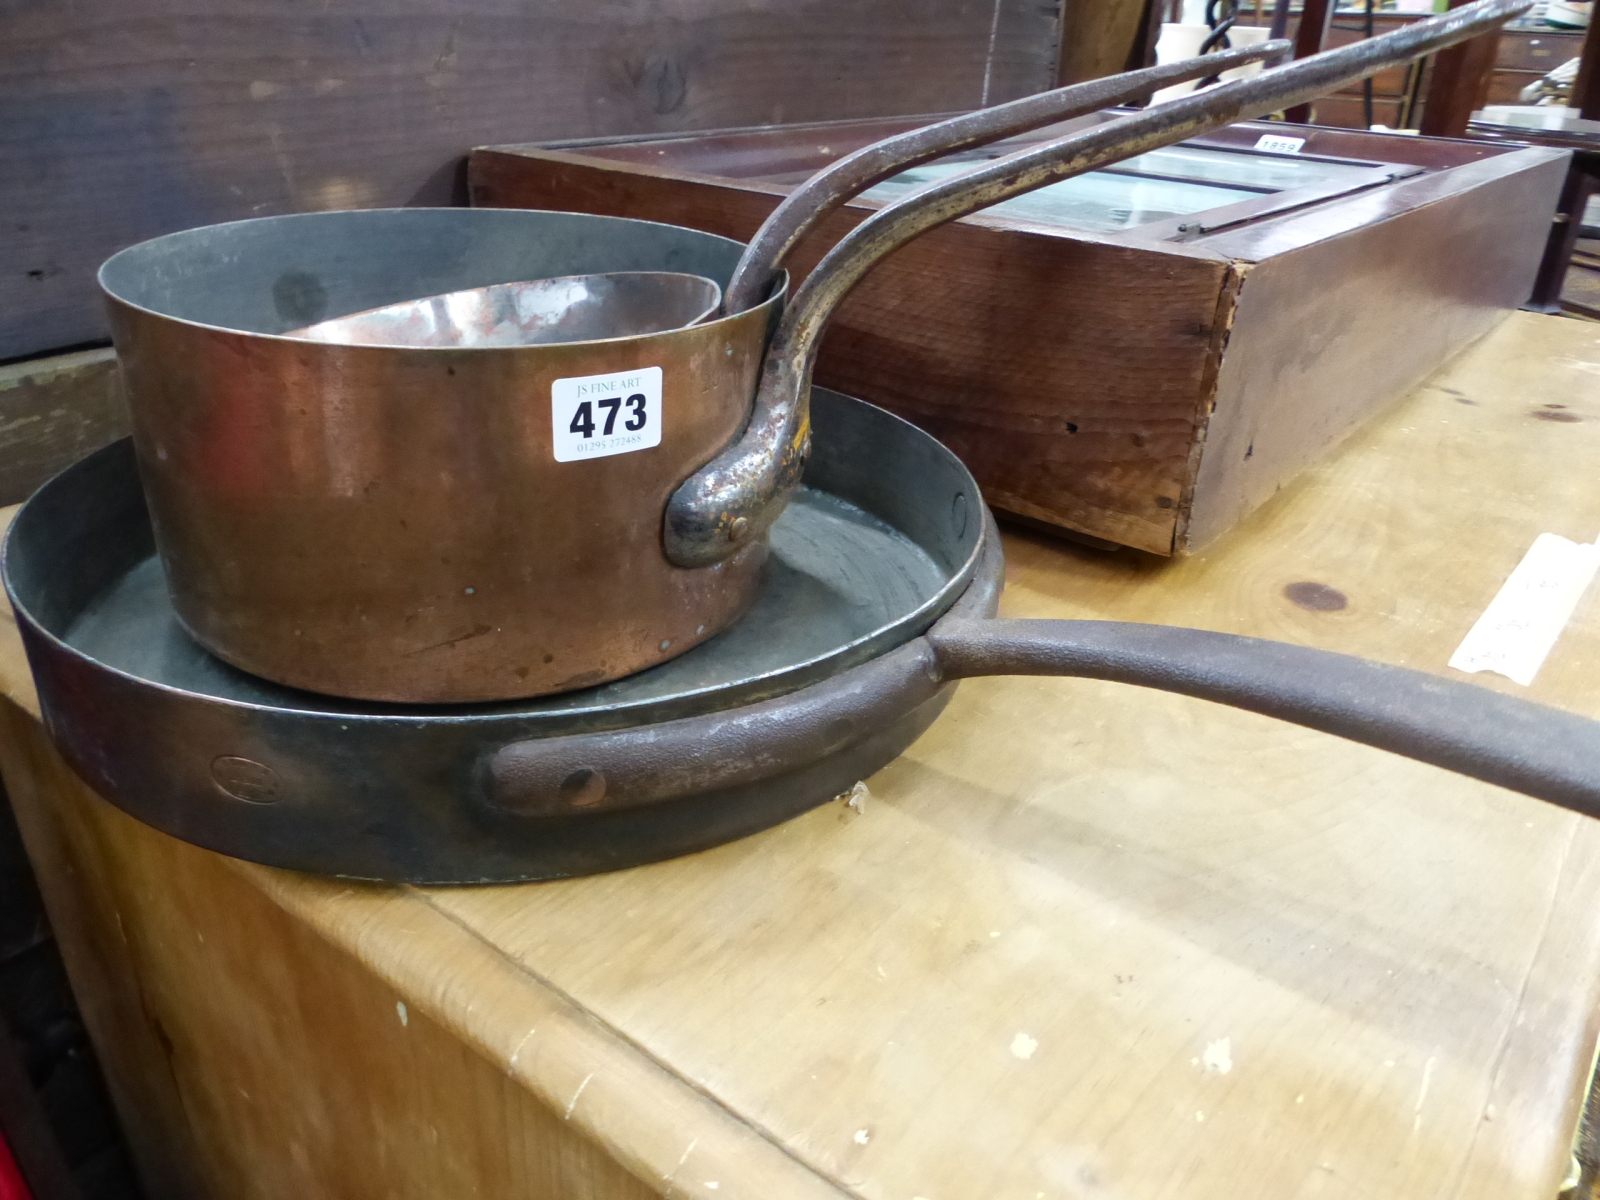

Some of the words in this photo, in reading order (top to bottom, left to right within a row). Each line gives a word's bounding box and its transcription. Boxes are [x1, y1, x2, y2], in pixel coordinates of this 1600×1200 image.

[1262, 141, 1296, 152] 1859
[577, 385, 588, 398] JS
[591, 381, 617, 393] FINE
[620, 377, 642, 389] ART
[569, 393, 647, 439] 473
[577, 440, 606, 453] 01295
[609, 434, 642, 448] 272488
